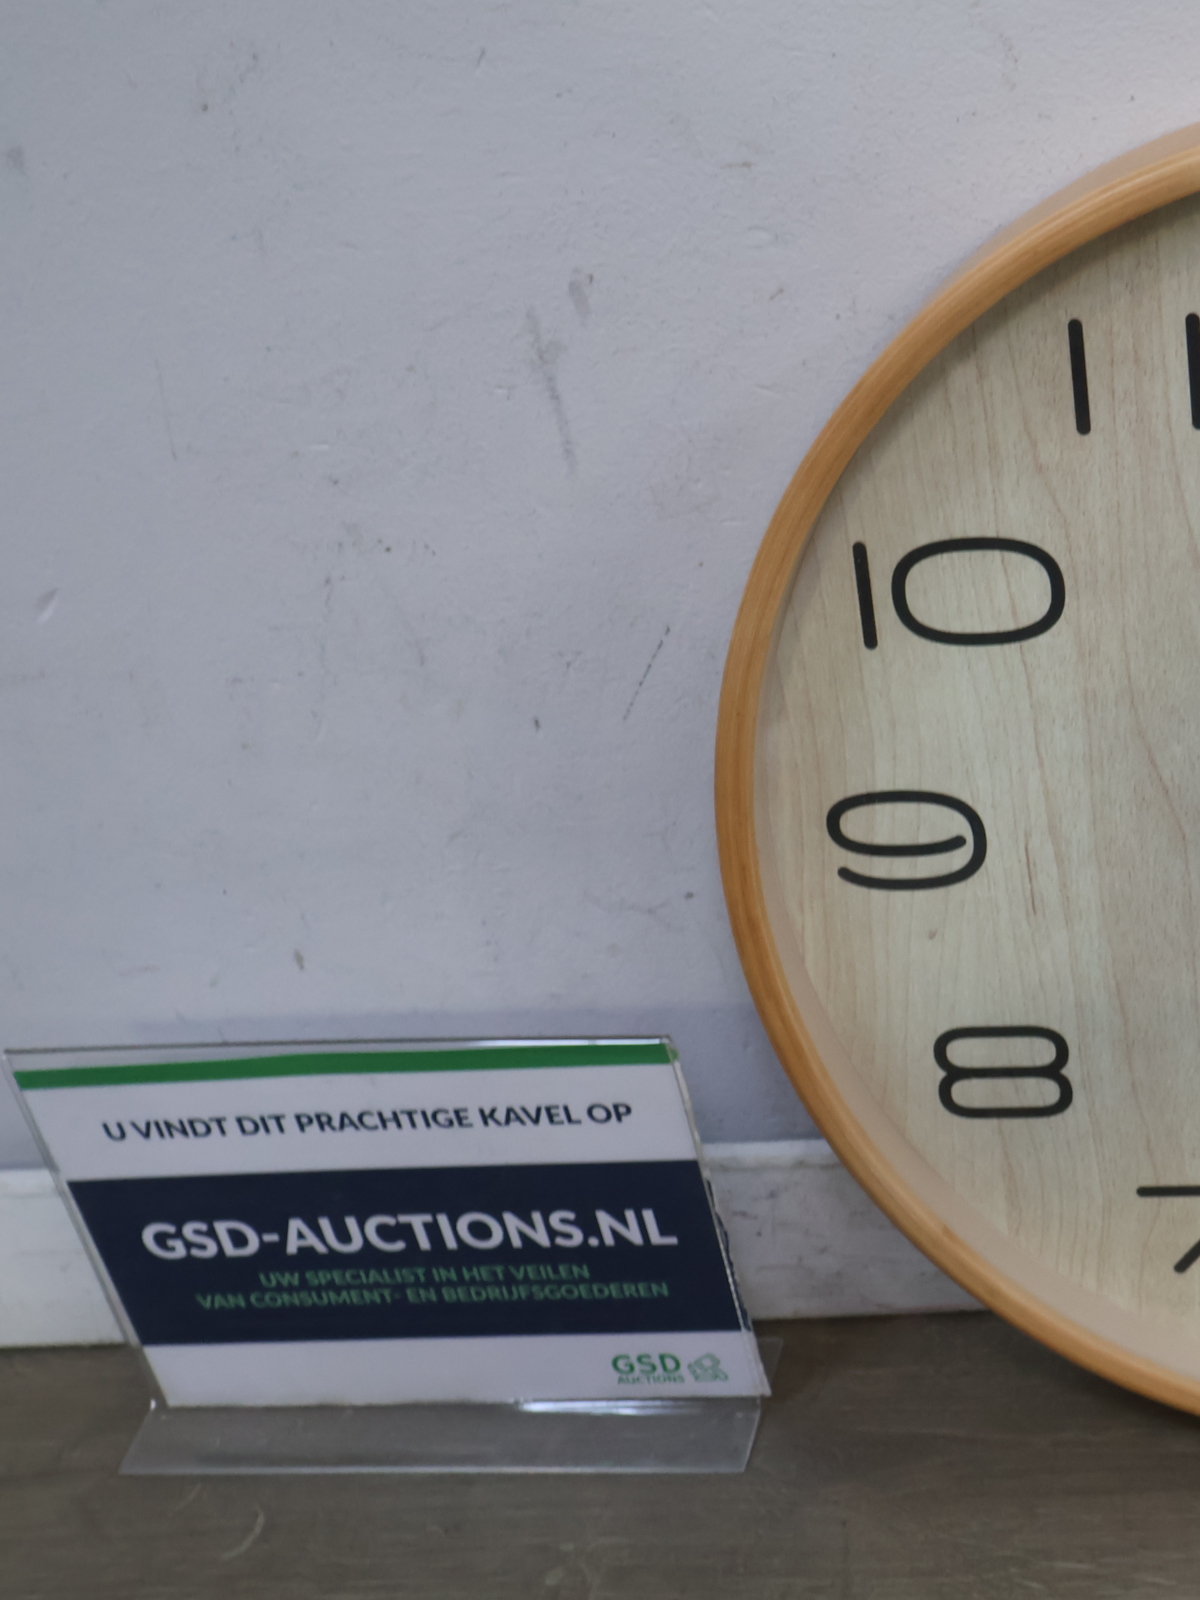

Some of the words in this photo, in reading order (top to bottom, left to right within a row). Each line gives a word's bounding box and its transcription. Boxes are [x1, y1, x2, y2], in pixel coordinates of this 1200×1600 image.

[852, 536, 1066, 650] 10
[826, 789, 987, 890] 9
[933, 1026, 1073, 1119] 8
[102, 1121, 127, 1142] U
[130, 1116, 226, 1140] VINDT
[235, 1114, 285, 1136] DIT
[294, 1107, 473, 1133] PRACHTIGE
[479, 1104, 582, 1127] KAVEL
[586, 1103, 633, 1124] OP
[141, 1208, 678, 1260] GSD-AUCTIONS.NL
[196, 1293, 246, 1309] VAN
[406, 1287, 437, 1304] EN
[441, 1282, 669, 1303] BEDRIJFSGOEDEREN
[258, 1271, 299, 1288] UW
[305, 1267, 425, 1286] SPECIALIST
[432, 1266, 457, 1282] IN
[462, 1265, 505, 1281] HET
[507, 1264, 590, 1281] VEILEN
[612, 1353, 681, 1375] GSD
[617, 1374, 685, 1385] AUCTIONS
